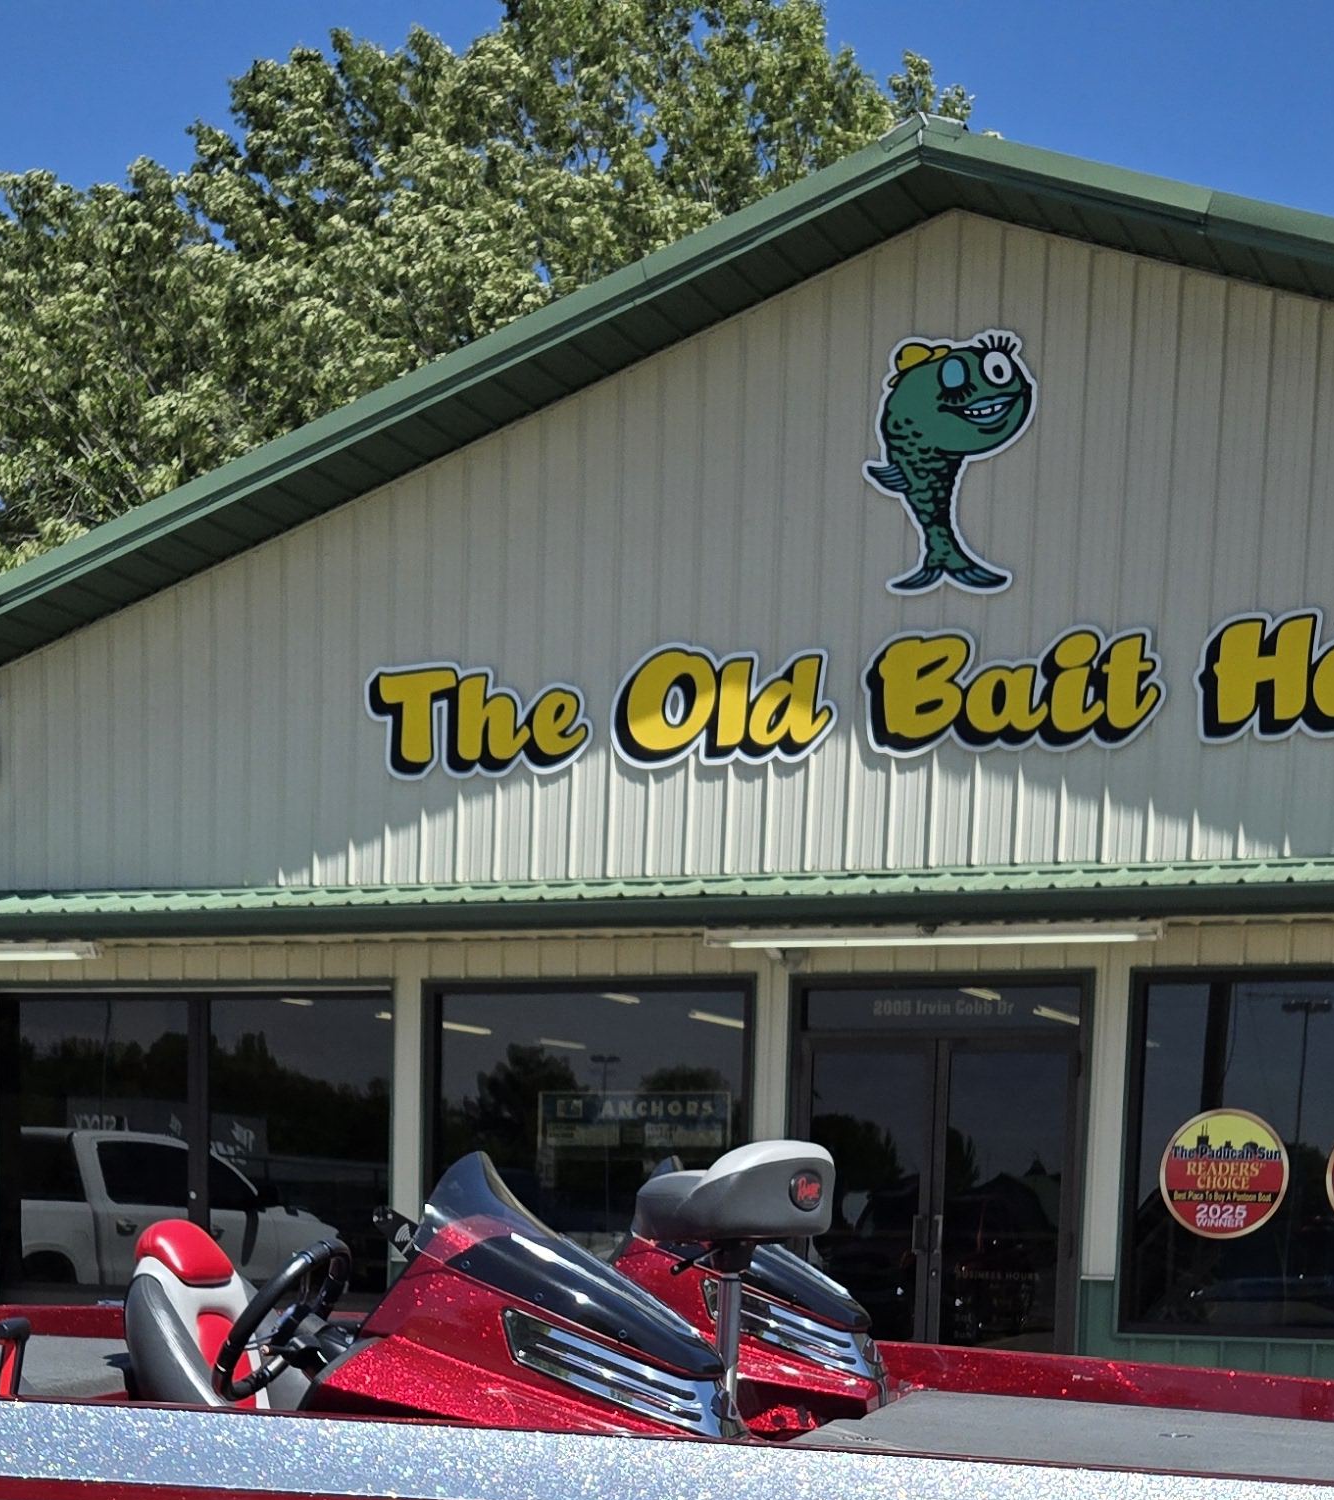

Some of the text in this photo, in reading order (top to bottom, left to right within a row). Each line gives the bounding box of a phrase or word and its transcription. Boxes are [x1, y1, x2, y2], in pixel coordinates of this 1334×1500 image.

[377, 668, 585, 774] The
[615, 647, 833, 763] Old
[872, 628, 1162, 750] Bait
[598, 1099, 714, 1119] ANCHORS
[1172, 1145, 1282, 1160] The Paducah Sun
[1197, 1176, 1250, 1189] CHOICE
[1195, 1204, 1247, 1218] 2025
[1196, 1217, 1244, 1228] WINNER
